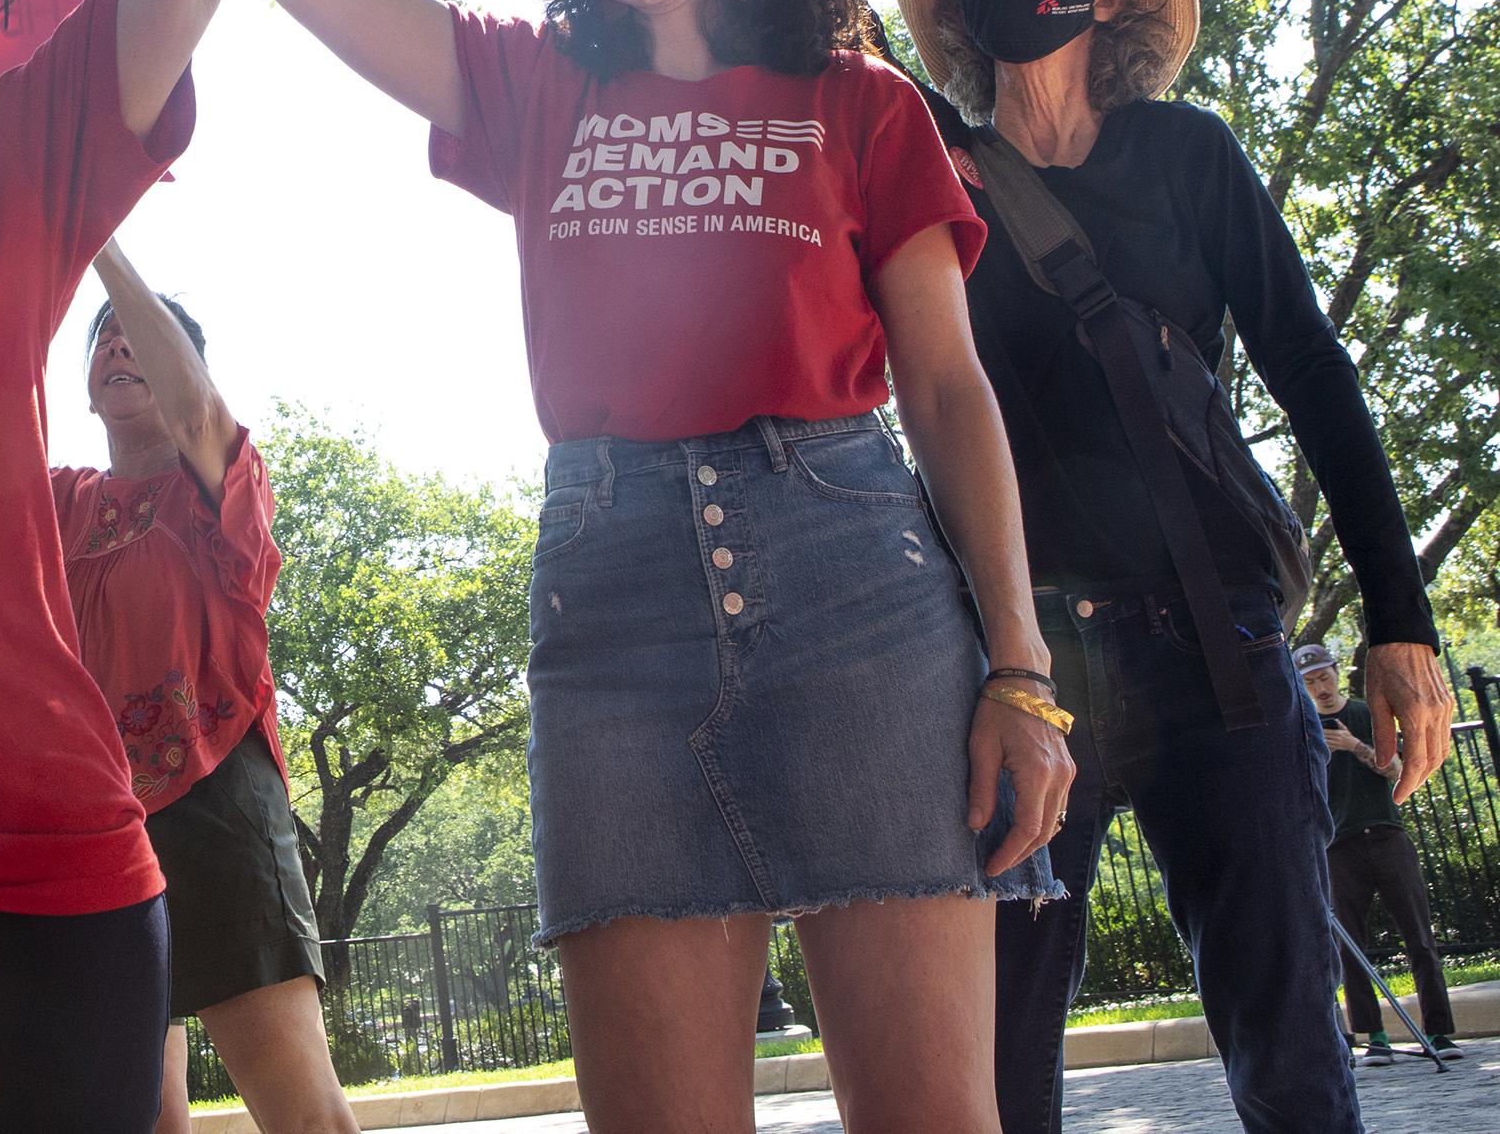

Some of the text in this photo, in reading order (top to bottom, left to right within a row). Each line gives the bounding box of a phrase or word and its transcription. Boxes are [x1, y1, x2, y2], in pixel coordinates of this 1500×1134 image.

[572, 111, 732, 147] MOMS
[562, 141, 800, 179] DEMAND
[550, 174, 764, 213] ACTION
[549, 214, 822, 247] FOR GUN SENSE IN AMERICA
